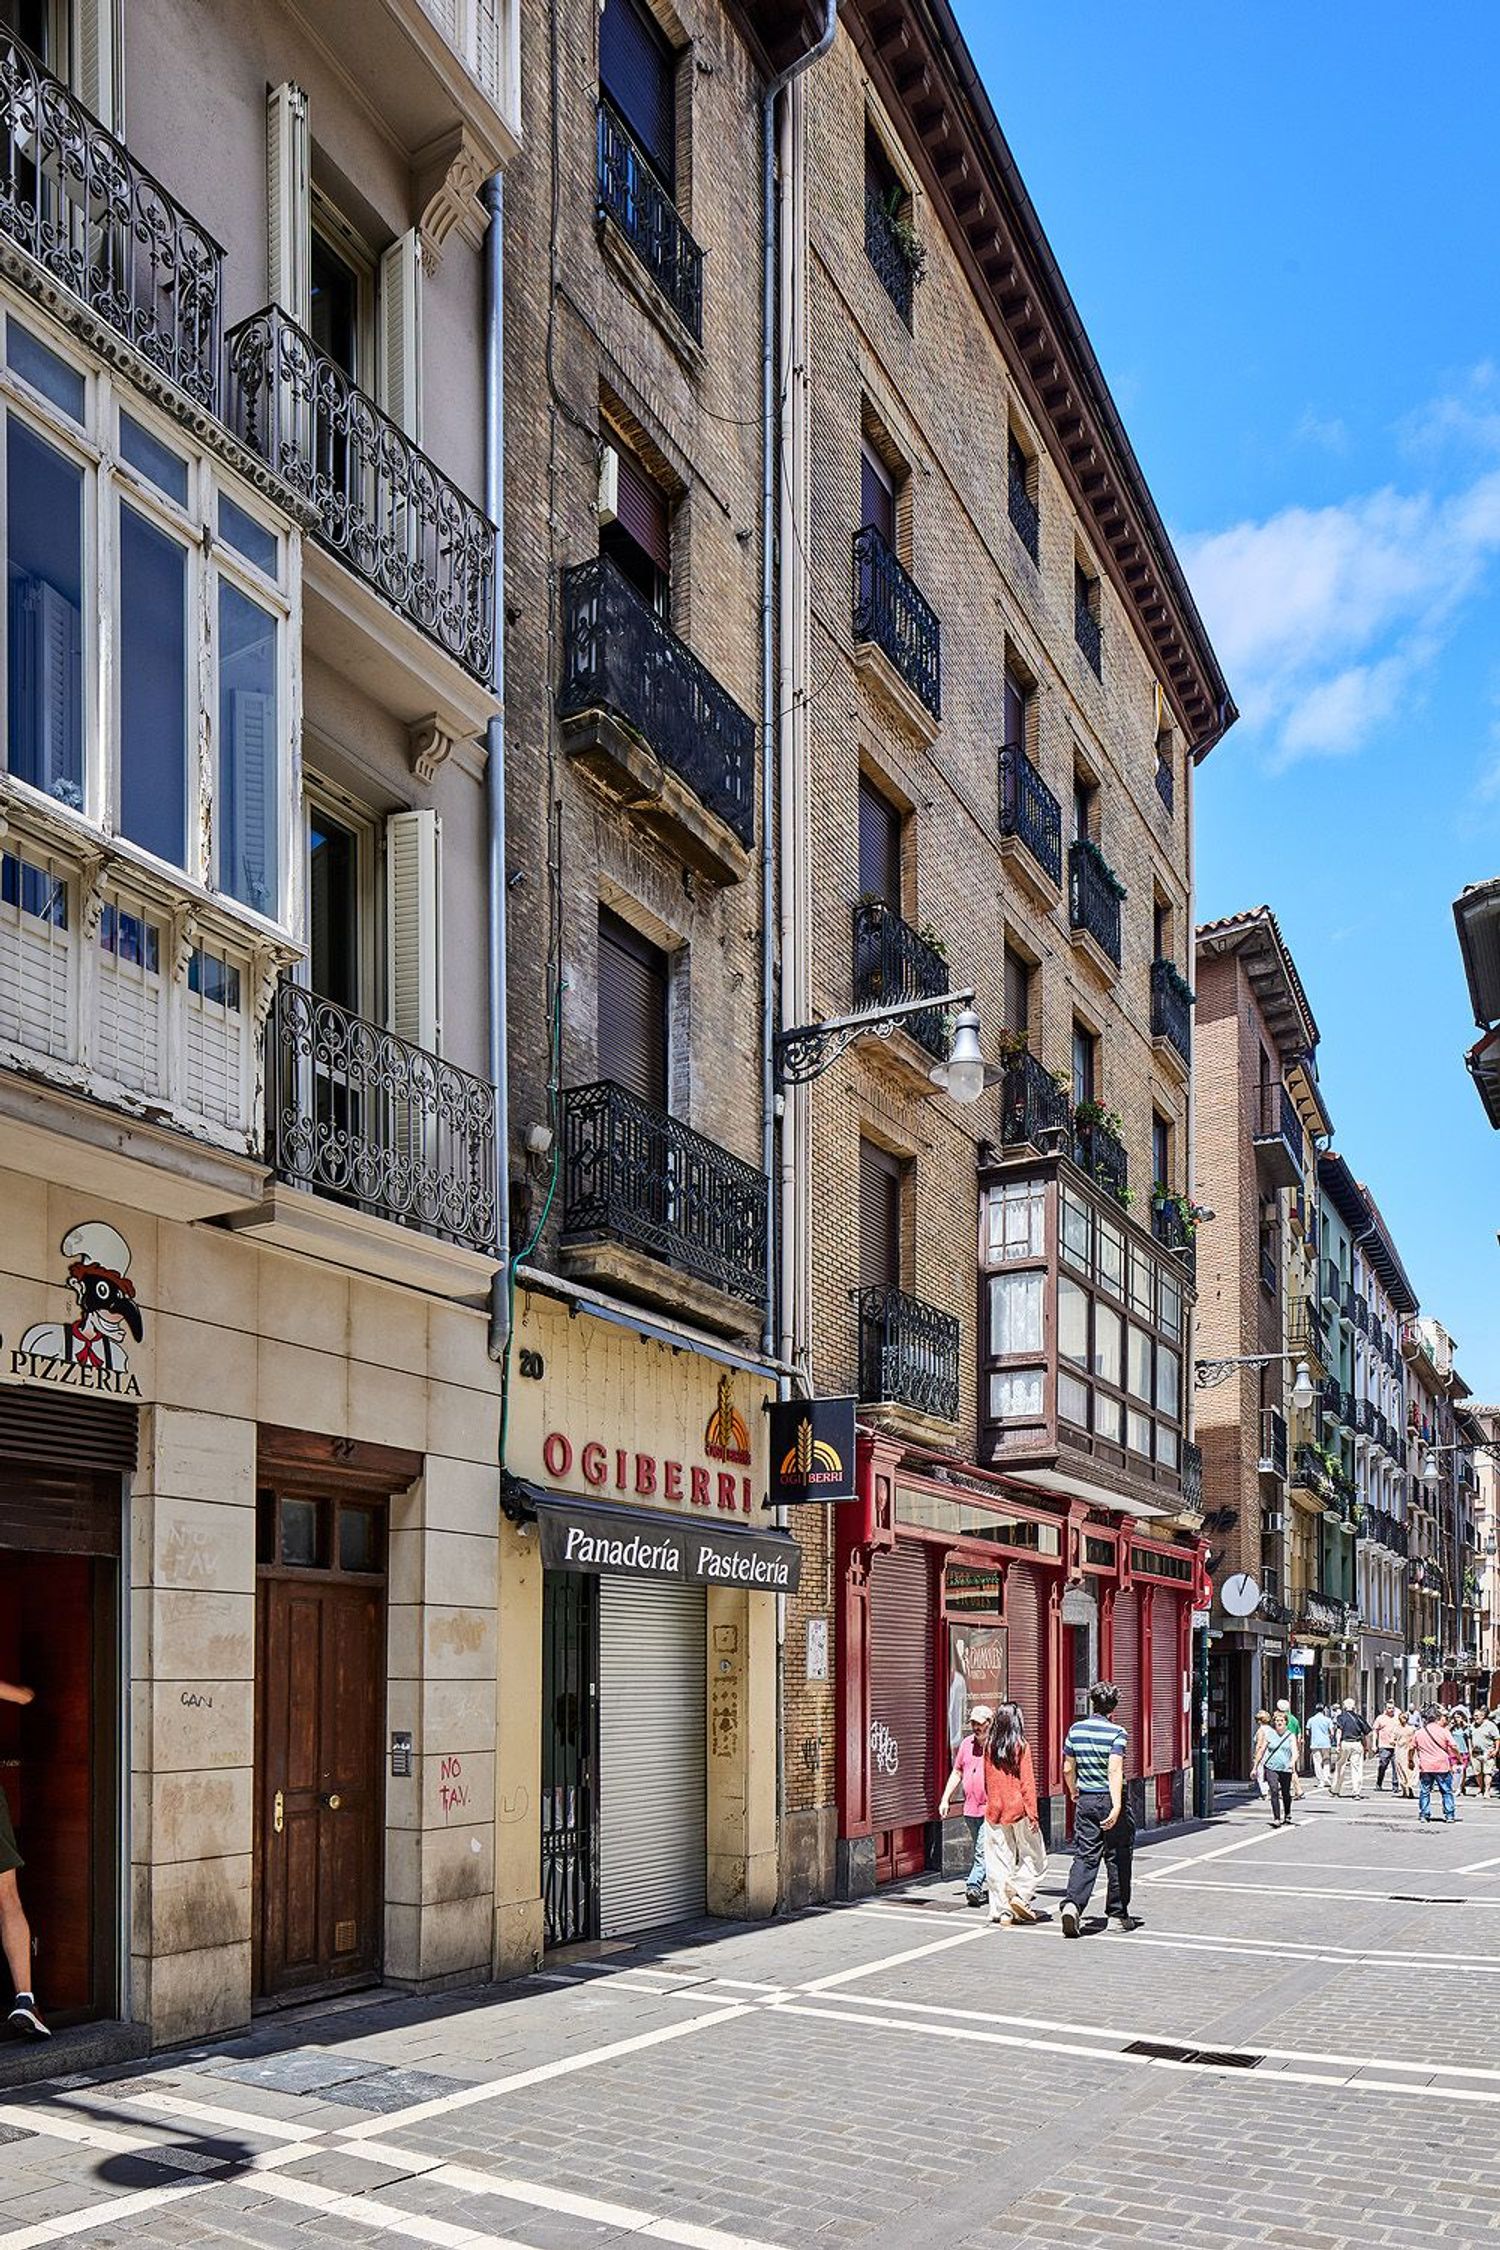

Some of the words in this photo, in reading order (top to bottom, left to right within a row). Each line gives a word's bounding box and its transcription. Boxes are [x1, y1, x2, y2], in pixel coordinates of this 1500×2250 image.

[10, 1350, 142, 1397] PIZZERIA
[519, 1349, 544, 1380] 20
[543, 1432, 752, 1514] OGIBERRI
[808, 1472, 843, 1483] BERRI
[565, 1527, 679, 1572] Panadería
[697, 1547, 789, 1585] Pastelería
[440, 1756, 462, 1781] NO
